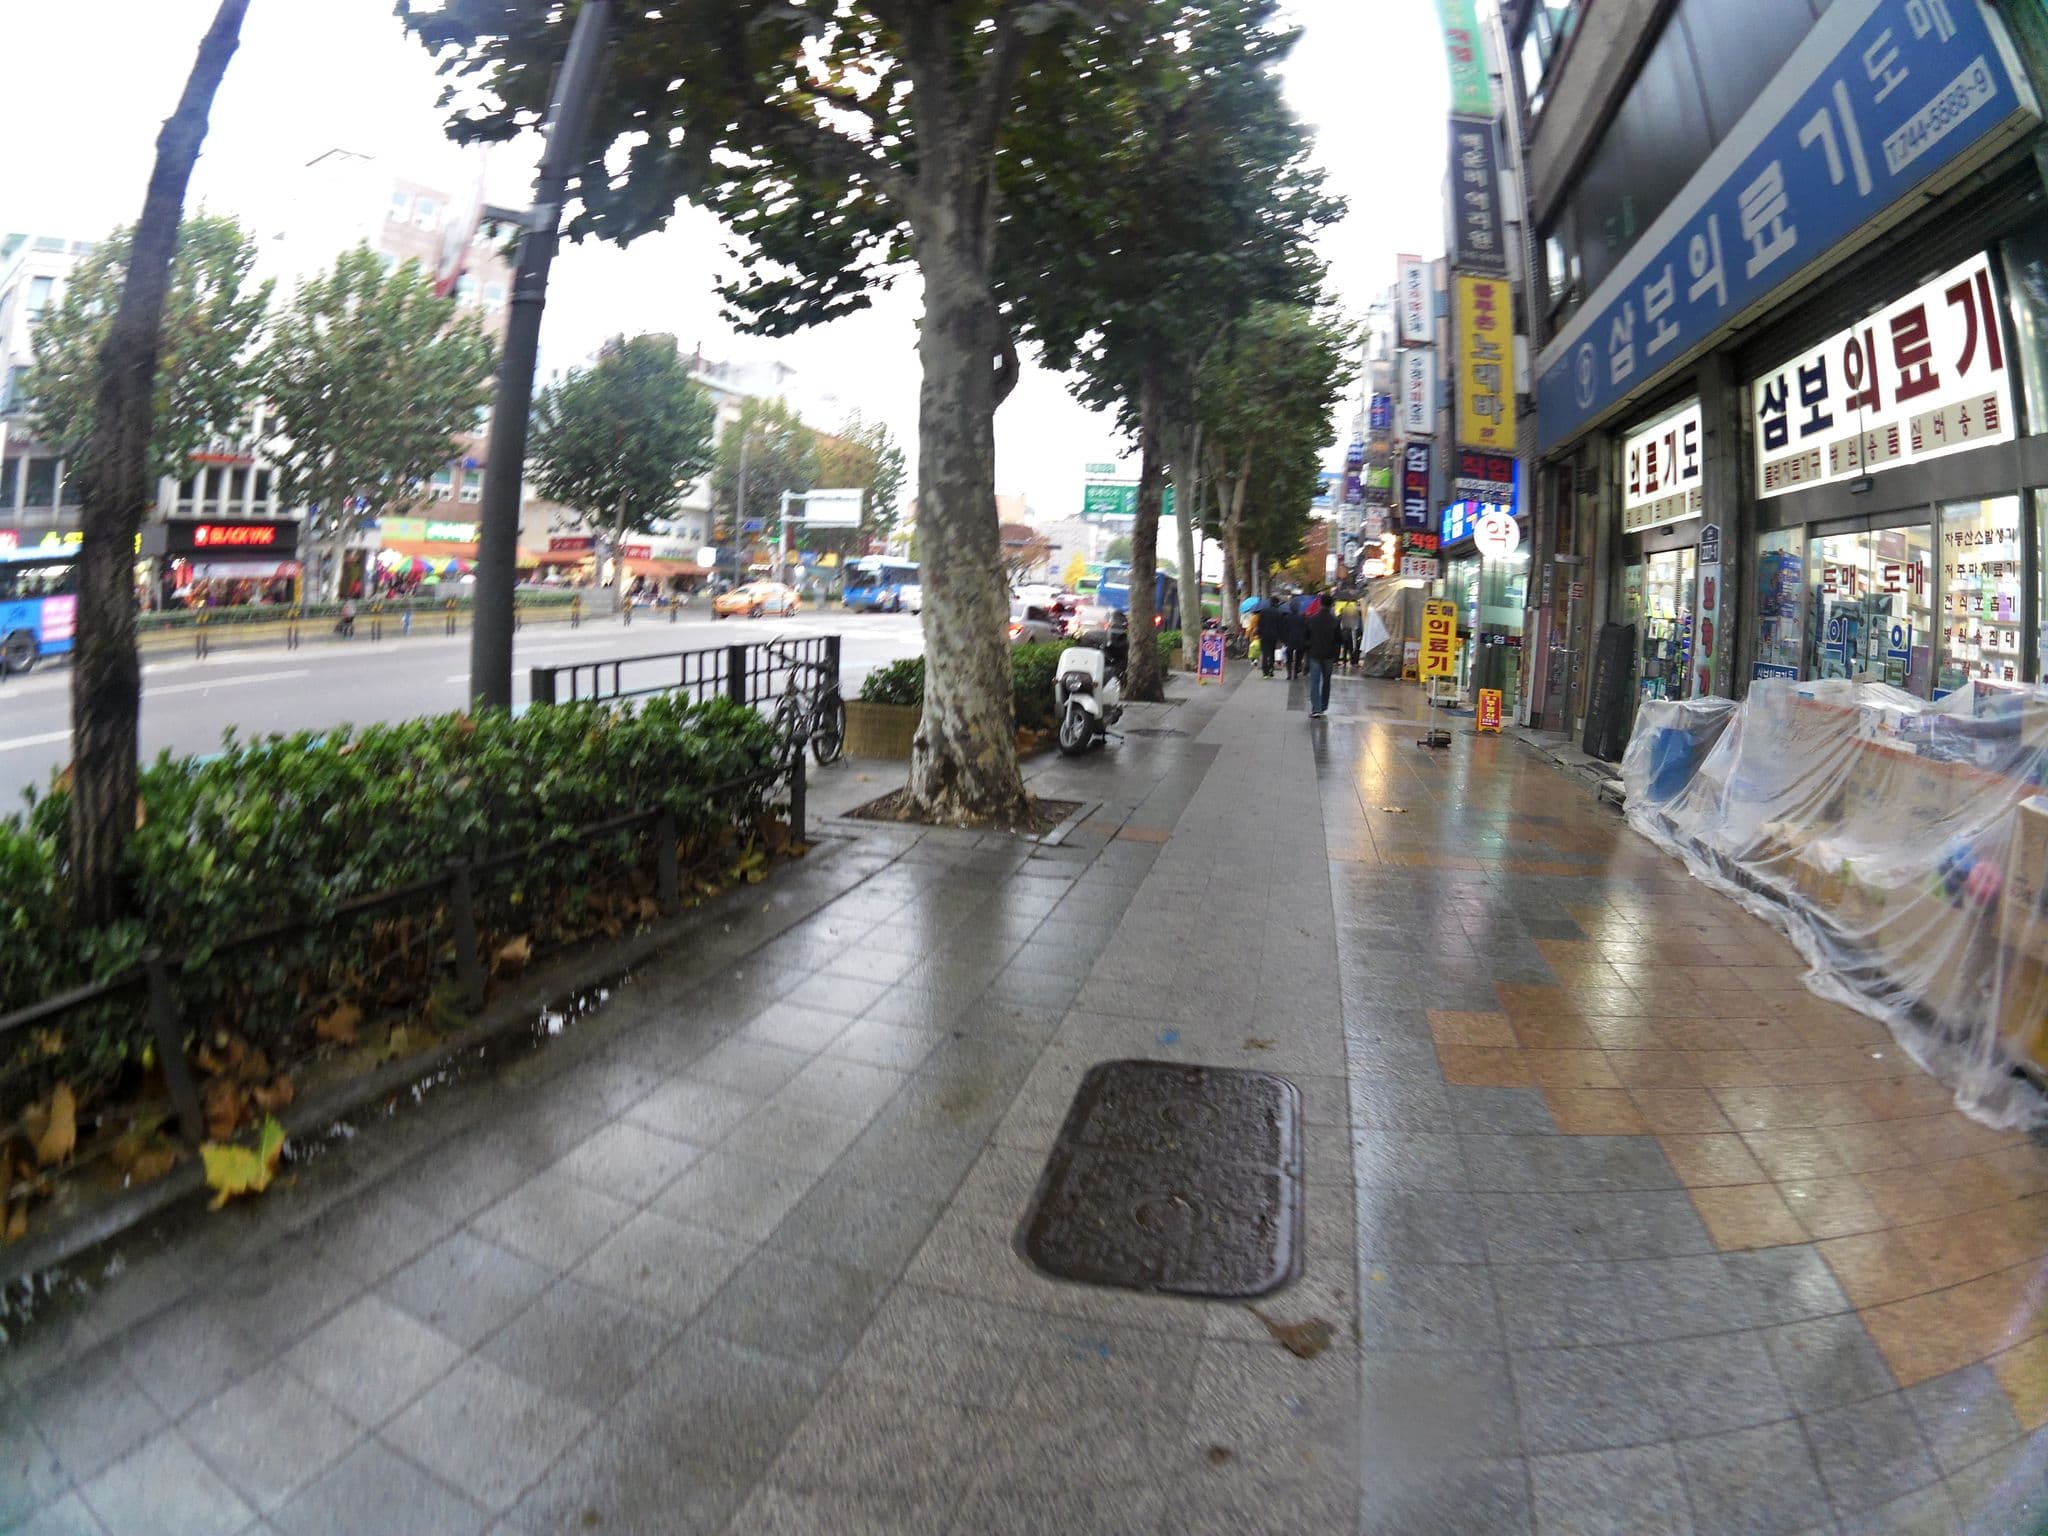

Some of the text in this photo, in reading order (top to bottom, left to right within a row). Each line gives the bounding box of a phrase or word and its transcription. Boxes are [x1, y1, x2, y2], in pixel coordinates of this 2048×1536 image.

[1944, 527, 2016, 547] 자동산소발생기
[1823, 564, 1856, 595] 도매
[1883, 560, 1924, 595] 도매
[1426, 603, 1454, 617] 도매
[1427, 619, 1450, 672] 의료기
